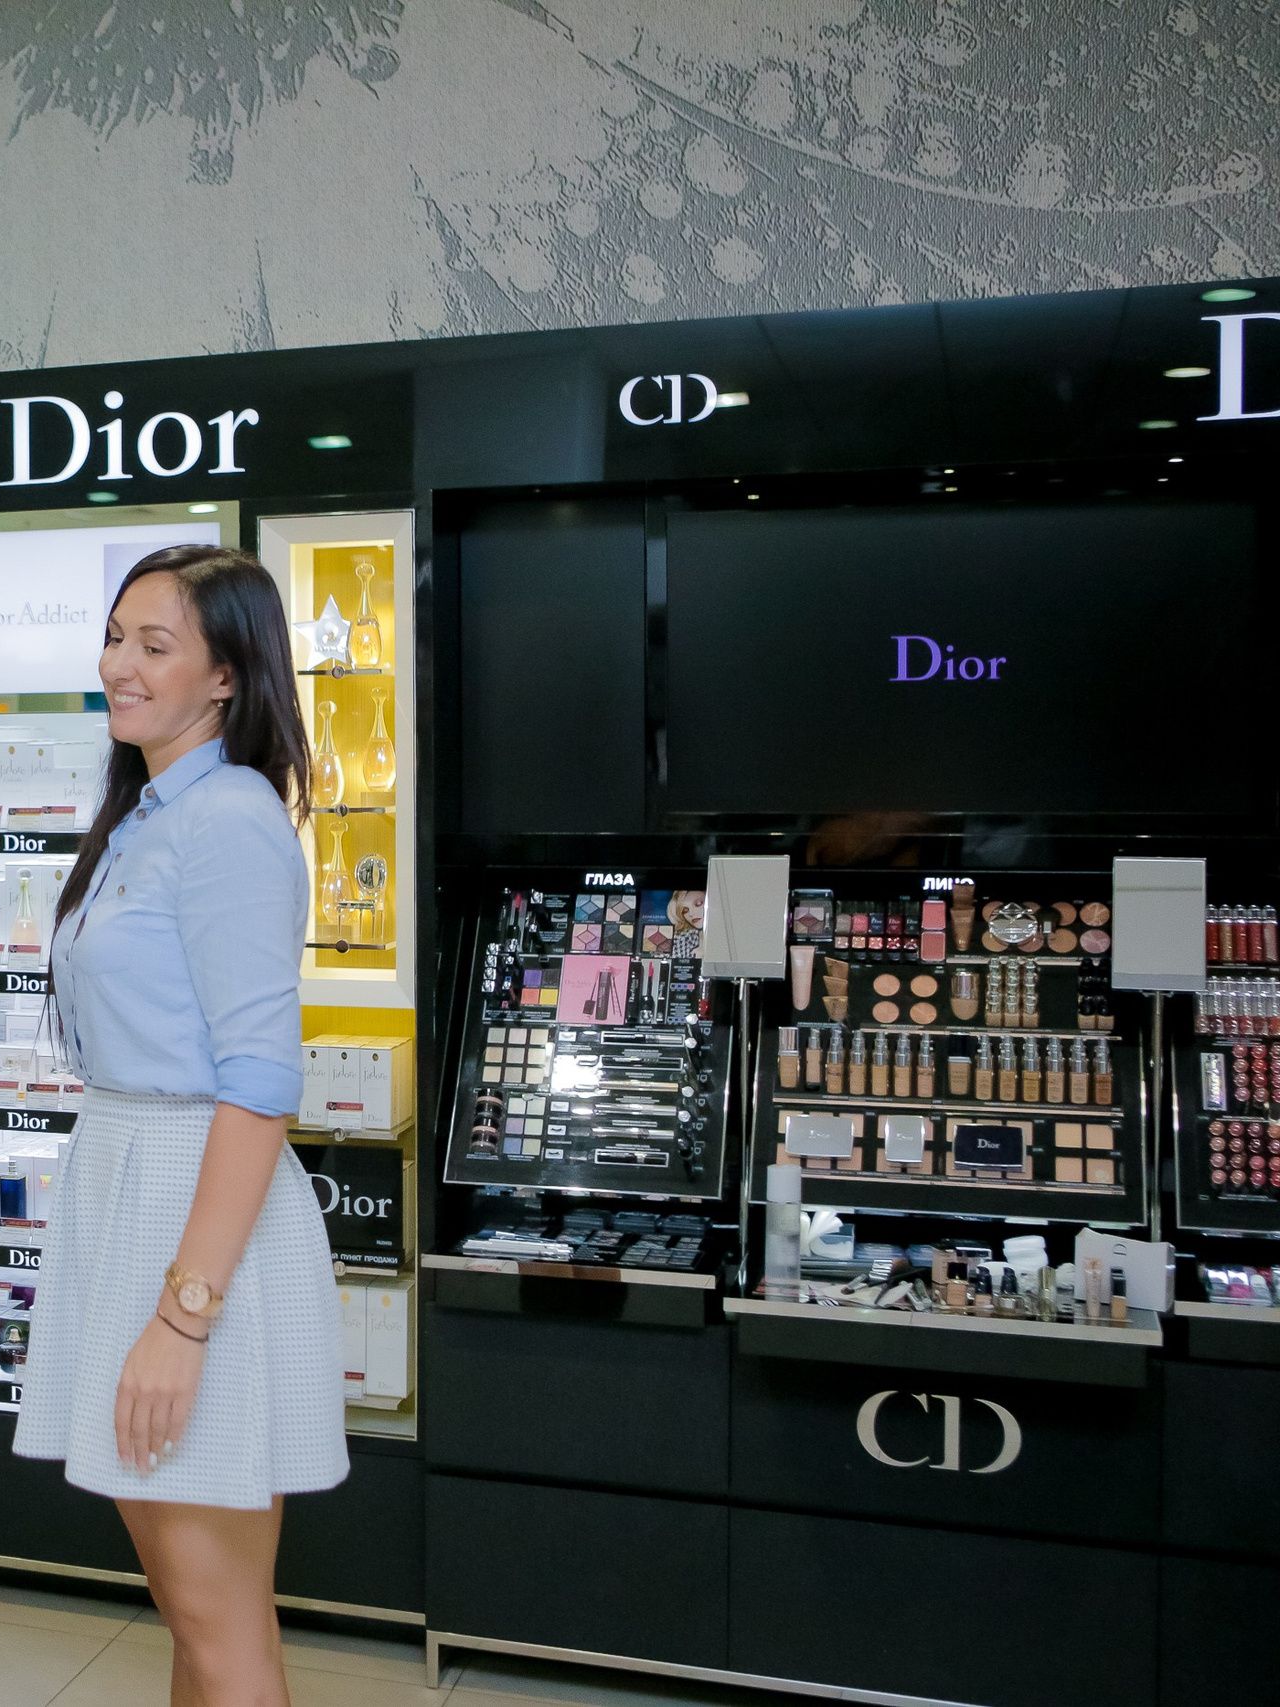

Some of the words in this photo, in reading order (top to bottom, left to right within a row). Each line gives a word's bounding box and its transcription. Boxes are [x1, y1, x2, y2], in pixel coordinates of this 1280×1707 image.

[1195, 312, 1280, 422] D
[17, 601, 89, 626] Addict
[889, 635, 1008, 682] Dior
[3, 834, 47, 852] Dior
[585, 873, 635, 887] ГЛАЗА
[6, 974, 48, 992] Dior
[7, 1111, 50, 1130] Dior
[977, 1138, 1000, 1149] Dior
[307, 1173, 393, 1218] Dior
[8, 1249, 42, 1268] Dio
[340, 1253, 362, 1261] ПУНКТ
[364, 1255, 398, 1264] ПРОДАЖИ
[11, 1385, 24, 1402] D
